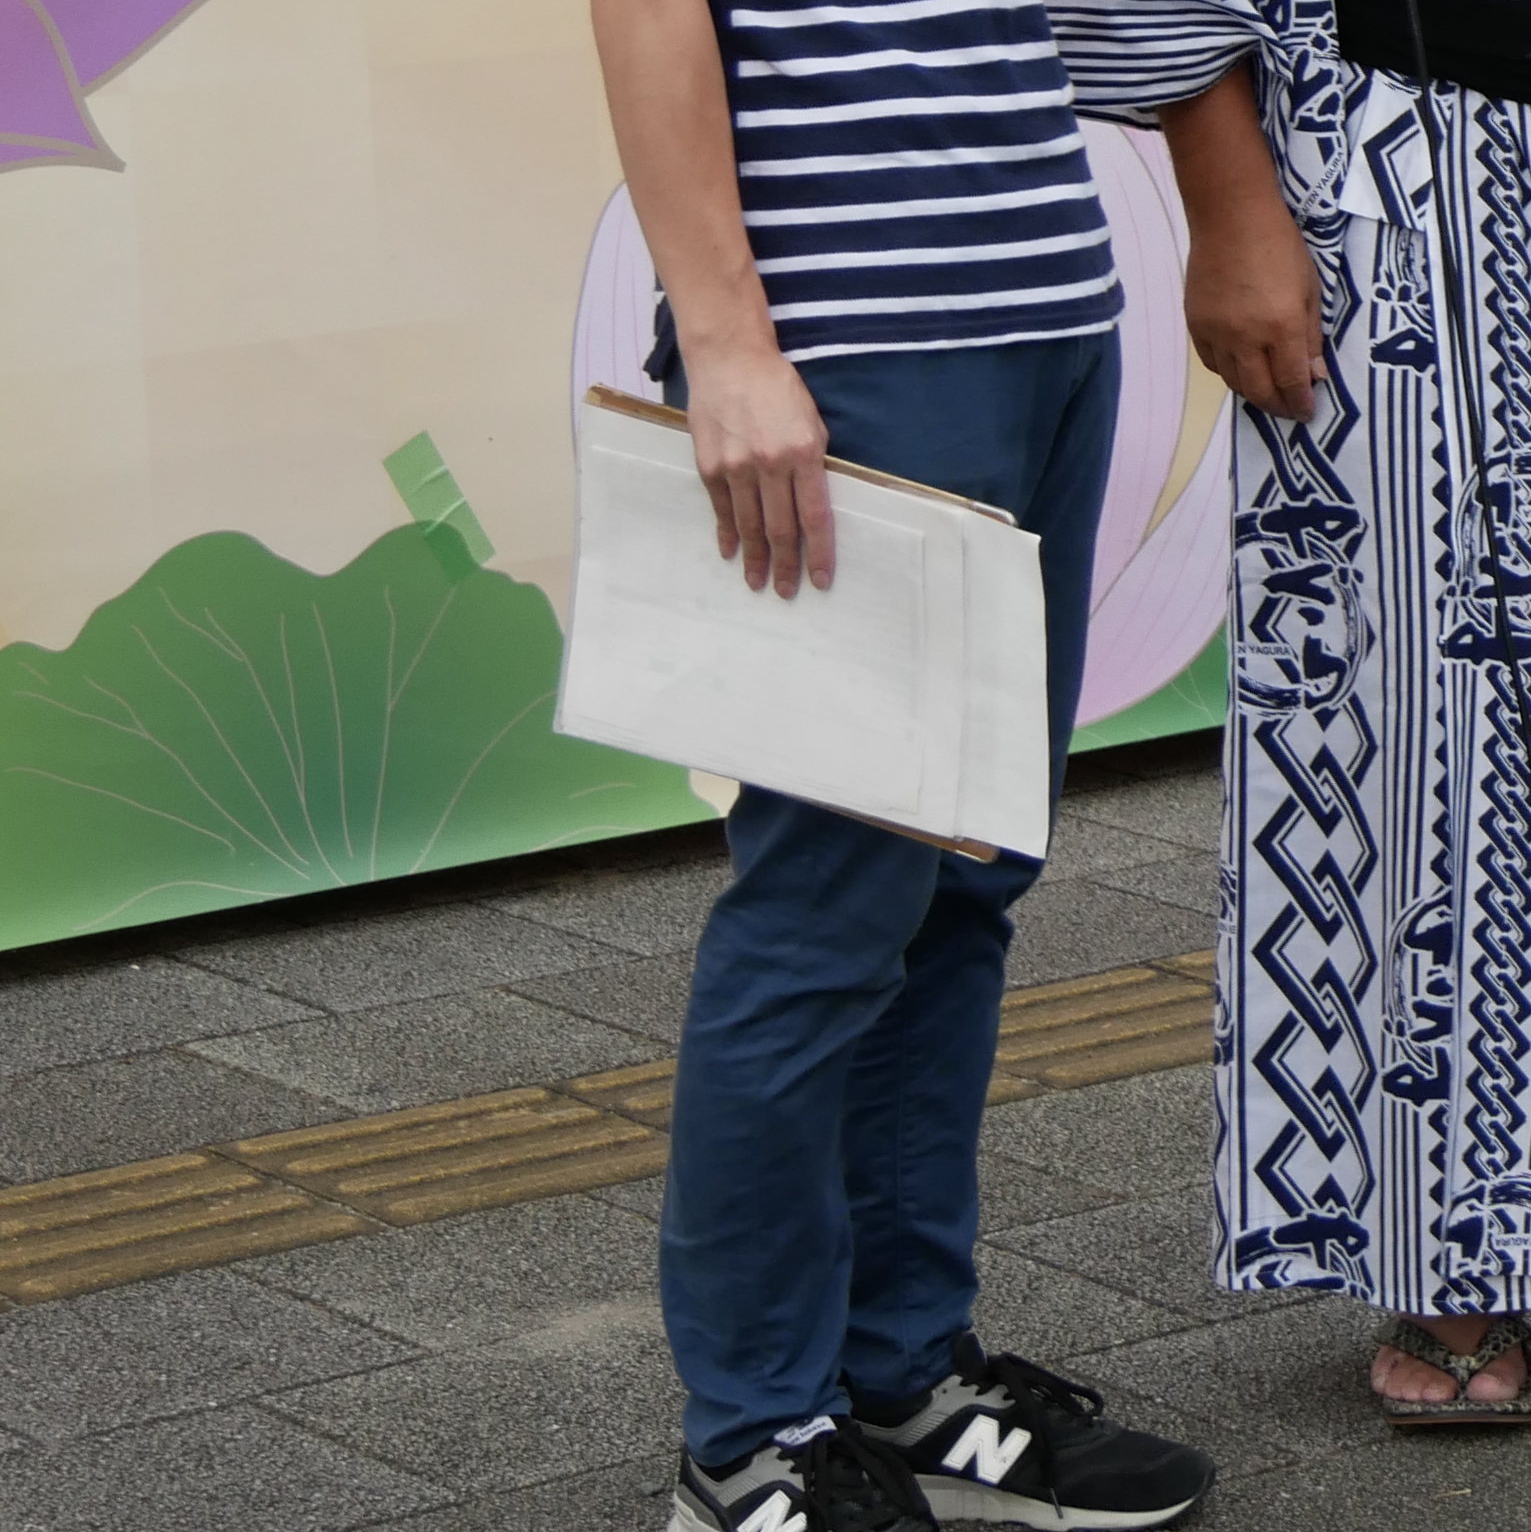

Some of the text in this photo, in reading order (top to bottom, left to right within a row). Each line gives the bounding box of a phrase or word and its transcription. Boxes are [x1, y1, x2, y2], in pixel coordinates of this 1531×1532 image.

[1316, 152, 1343, 190] YAGURA
[1248, 646, 1291, 656] YAGURA
[941, 1413, 1032, 1486] N
